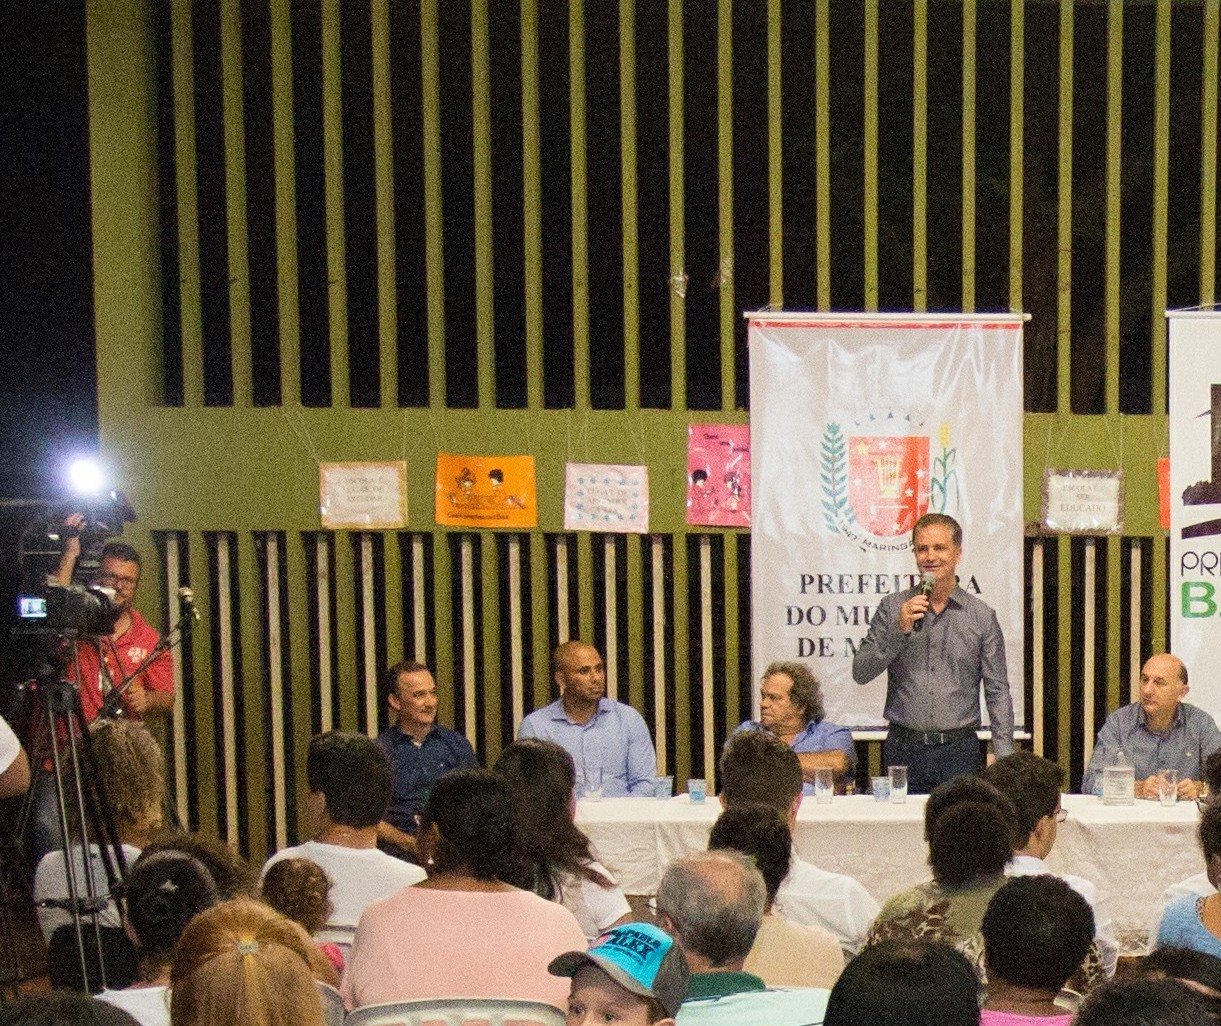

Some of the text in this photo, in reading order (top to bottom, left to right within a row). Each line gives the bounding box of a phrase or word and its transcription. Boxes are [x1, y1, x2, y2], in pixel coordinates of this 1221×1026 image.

[1060, 503, 1106, 512] EDUCADO
[800, 573, 982, 595] PREFEITA
[785, 605, 827, 627] DO
[797, 637, 834, 658] DE
